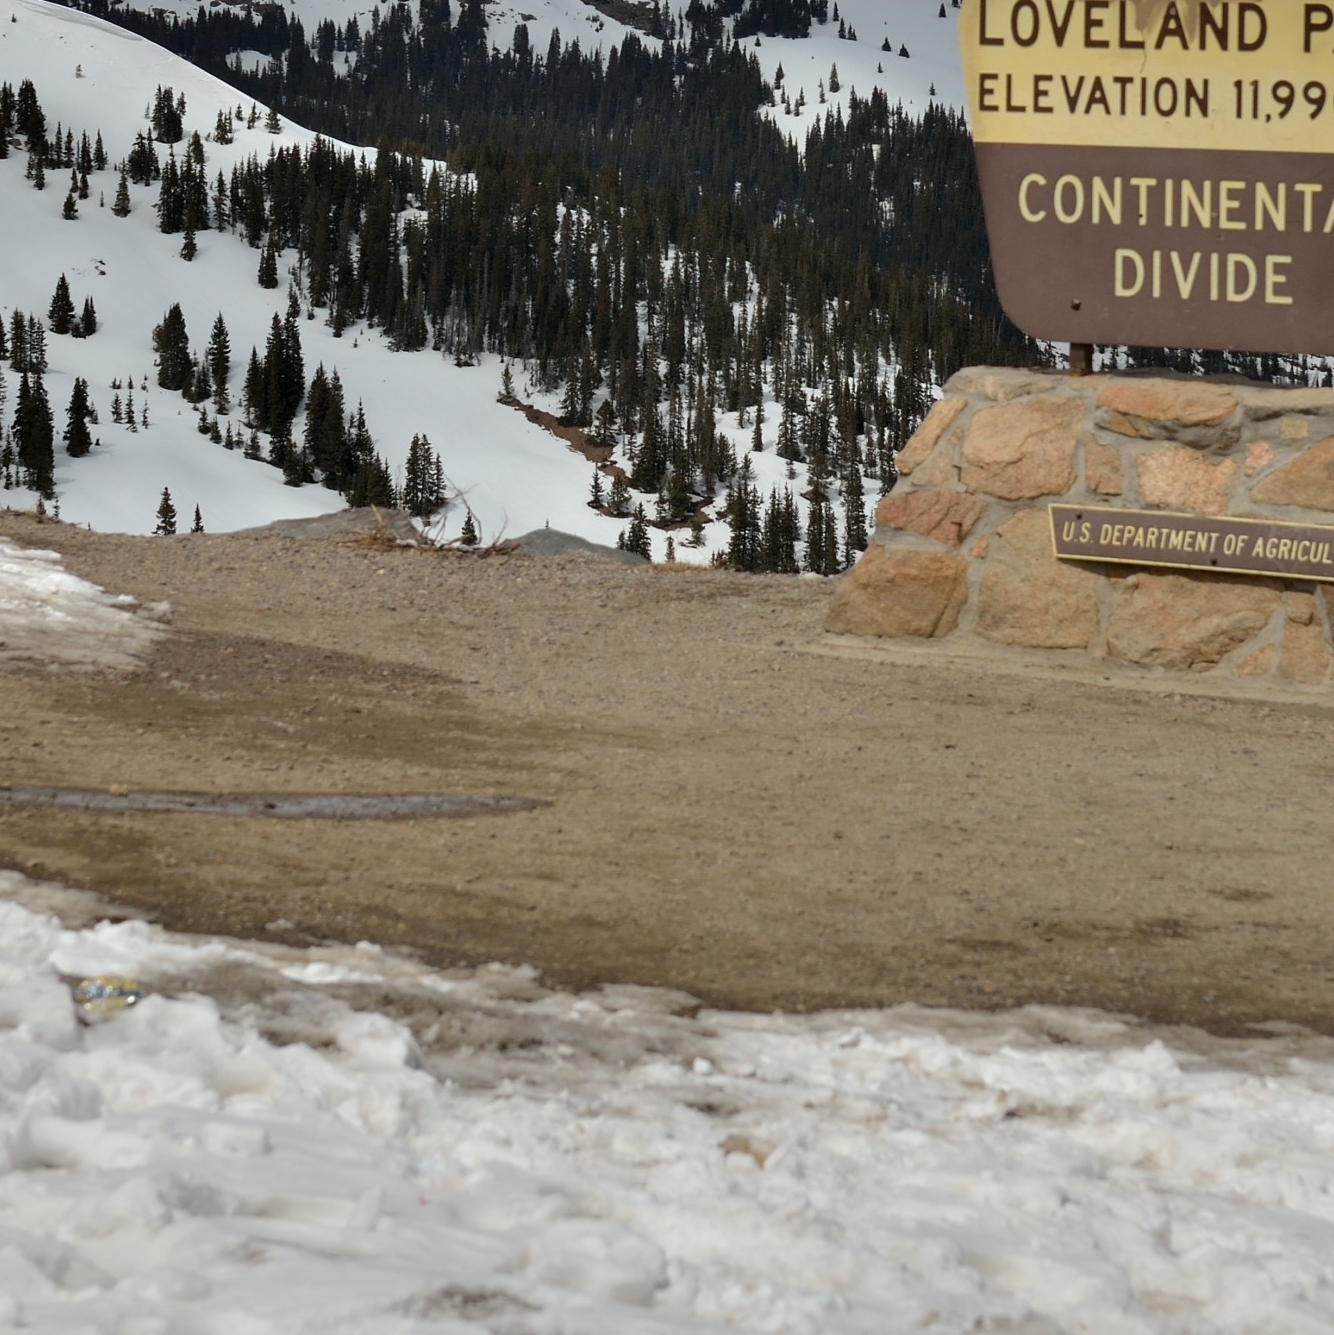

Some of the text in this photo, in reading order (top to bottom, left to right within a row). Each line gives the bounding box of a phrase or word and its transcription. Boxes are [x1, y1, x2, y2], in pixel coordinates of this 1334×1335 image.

[978, 73, 1209, 118] ELEVATION
[1114, 248, 1294, 305] DIVIDE
[1062, 521, 1094, 544] U.S.
[1100, 524, 1218, 553] DEPARTMENT
[1223, 533, 1246, 556] OF
